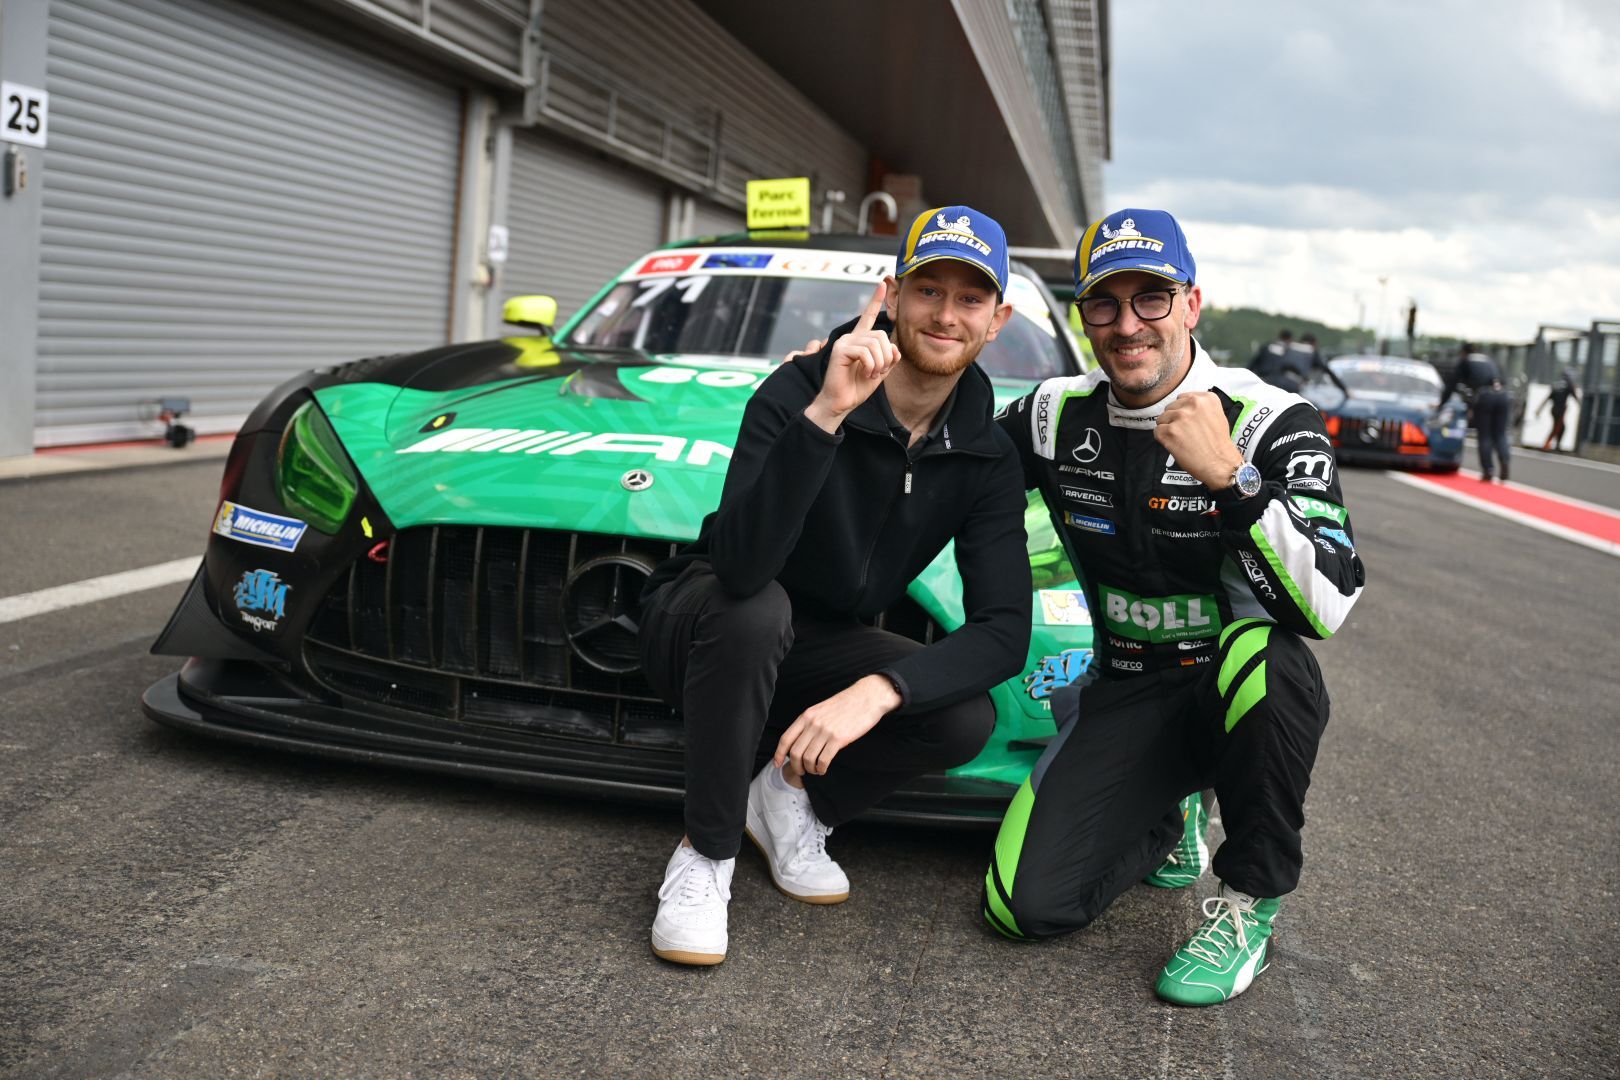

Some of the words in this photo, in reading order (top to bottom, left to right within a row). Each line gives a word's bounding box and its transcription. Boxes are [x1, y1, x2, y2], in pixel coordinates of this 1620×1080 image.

[8, 95, 40, 134] 25
[918, 232, 992, 257] MICHELIN
[1090, 239, 1163, 264] MICHELIN
[1037, 393, 1051, 445] sparco
[1075, 467, 1115, 480] AMG
[1065, 489, 1107, 503] RAVENOL
[233, 515, 302, 540] MICHELIN
[1075, 518, 1110, 530] MICHELIN
[1106, 592, 1210, 630] BOLL
[1111, 658, 1143, 670] sparco
